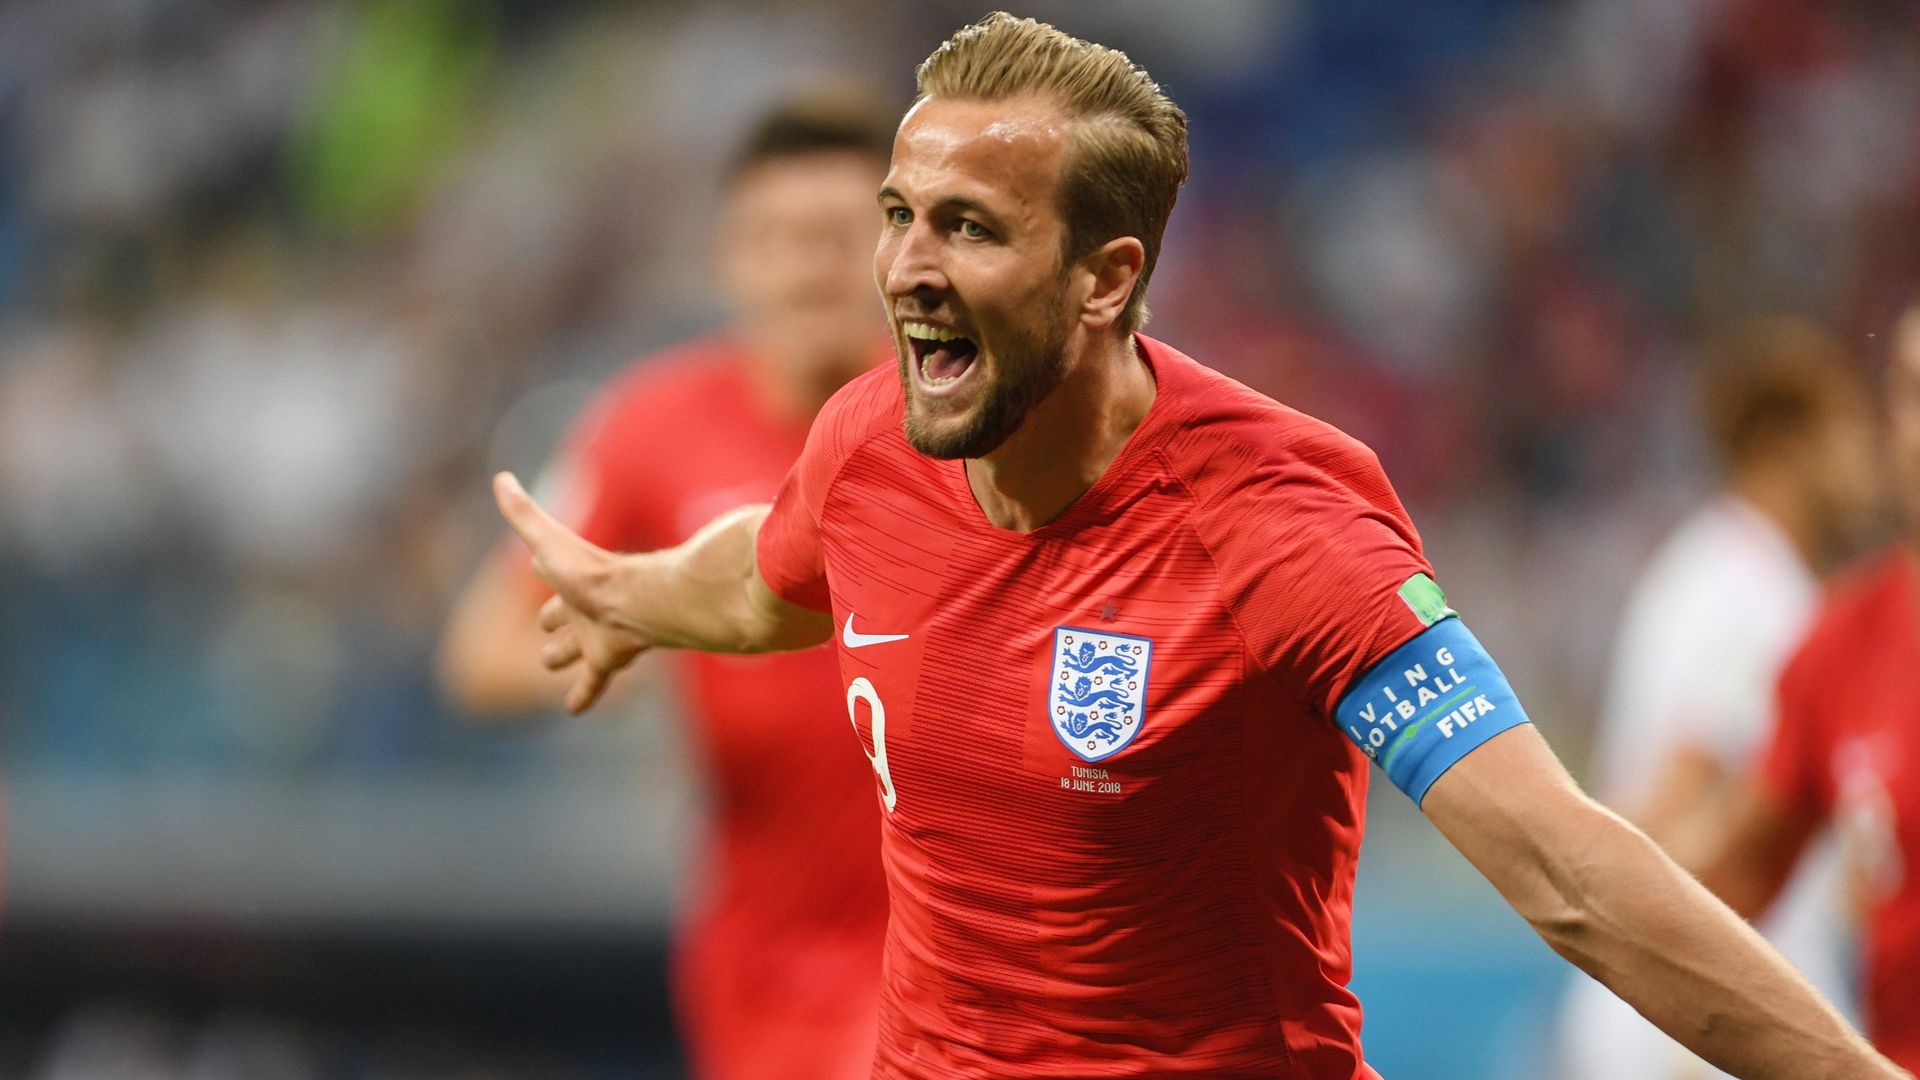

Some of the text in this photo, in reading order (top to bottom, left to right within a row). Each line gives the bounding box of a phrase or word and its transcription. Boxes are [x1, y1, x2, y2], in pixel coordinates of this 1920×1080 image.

[1350, 647, 1455, 740] IVING
[1363, 668, 1467, 758] OTBALL
[1436, 694, 1496, 738] FIFA
[847, 676, 897, 813] 9
[1071, 766, 1109, 779] TUNISIA
[1061, 777, 1121, 793] 18 JUNE 2018
